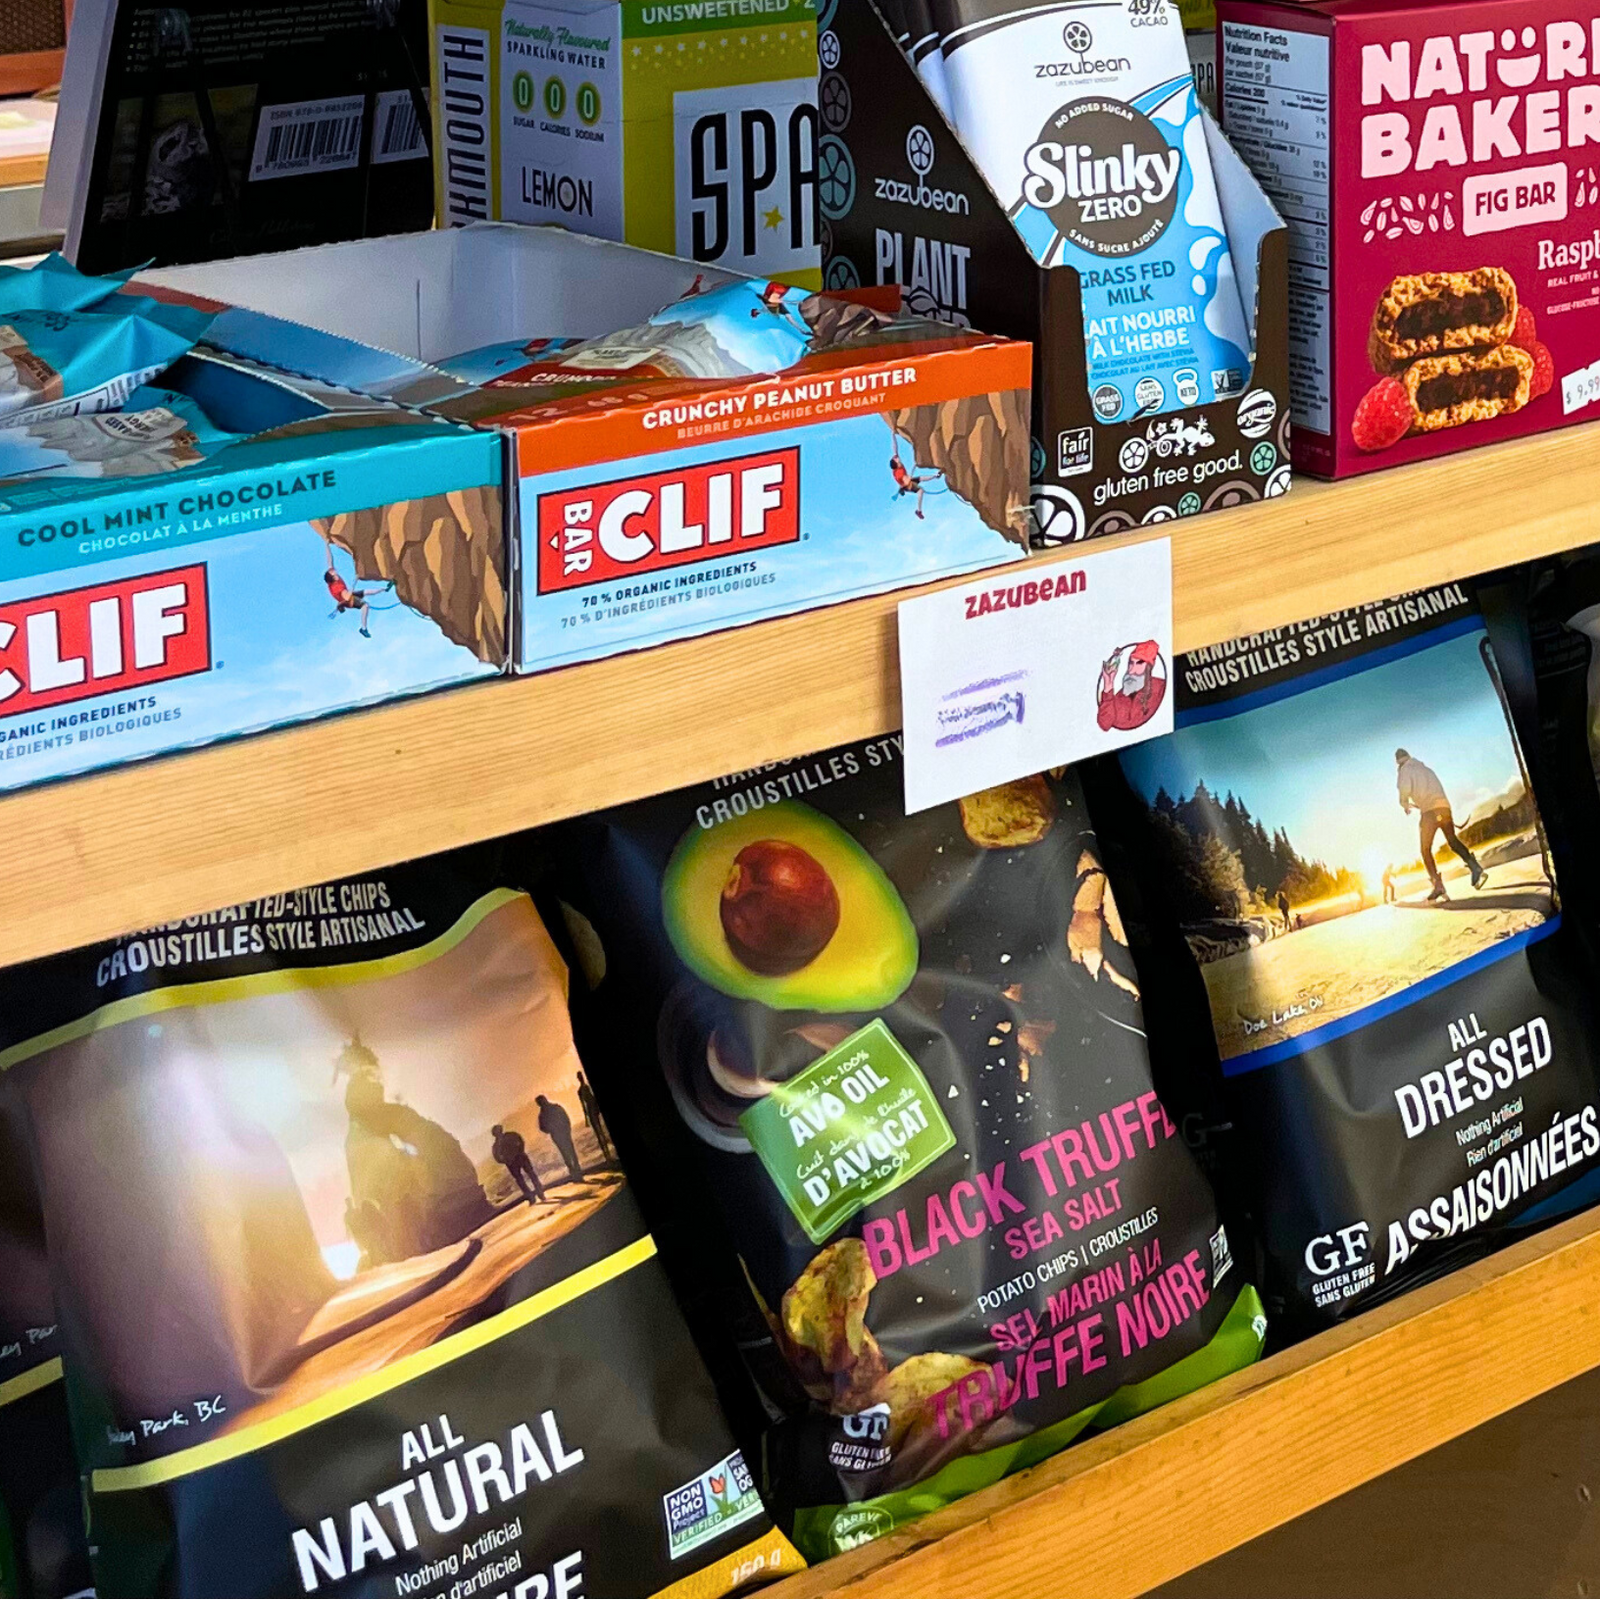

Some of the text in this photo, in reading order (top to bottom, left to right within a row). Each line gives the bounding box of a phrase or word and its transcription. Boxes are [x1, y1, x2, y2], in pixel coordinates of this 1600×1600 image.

[1129, 14, 1168, 28] CACAO
[507, 40, 606, 69] SPARKLING WATER
[1034, 55, 1130, 81] zazubean
[522, 166, 593, 217] LEMON
[1028, 141, 1178, 203] Slinky
[1080, 198, 1142, 223] ZERO
[1475, 181, 1556, 216] FIG BAR
[642, 367, 916, 429] CRUNCHY PEANUT BUTTER
[1576, 376, 1600, 400] 9.99
[18, 470, 337, 547] COOL MINT CHOCOLATE
[1093, 470, 1151, 506] gluten
[1153, 463, 1191, 487] free
[564, 464, 784, 576] BAR CLIF
[582, 595, 597, 608] 70
[616, 578, 671, 602] ORGANIC
[675, 562, 757, 589] INGREDIENTS
[1449, 1014, 1487, 1052] ALL
[844, 1067, 889, 1110] OIL
[1395, 1016, 1553, 1139] DRESSED
[802, 1098, 931, 1206] D'AVOCAT
[1384, 1109, 1600, 1276] ASSAISONNÉES
[402, 1415, 464, 1470] ALL
[293, 1410, 584, 1592] NATURAL
